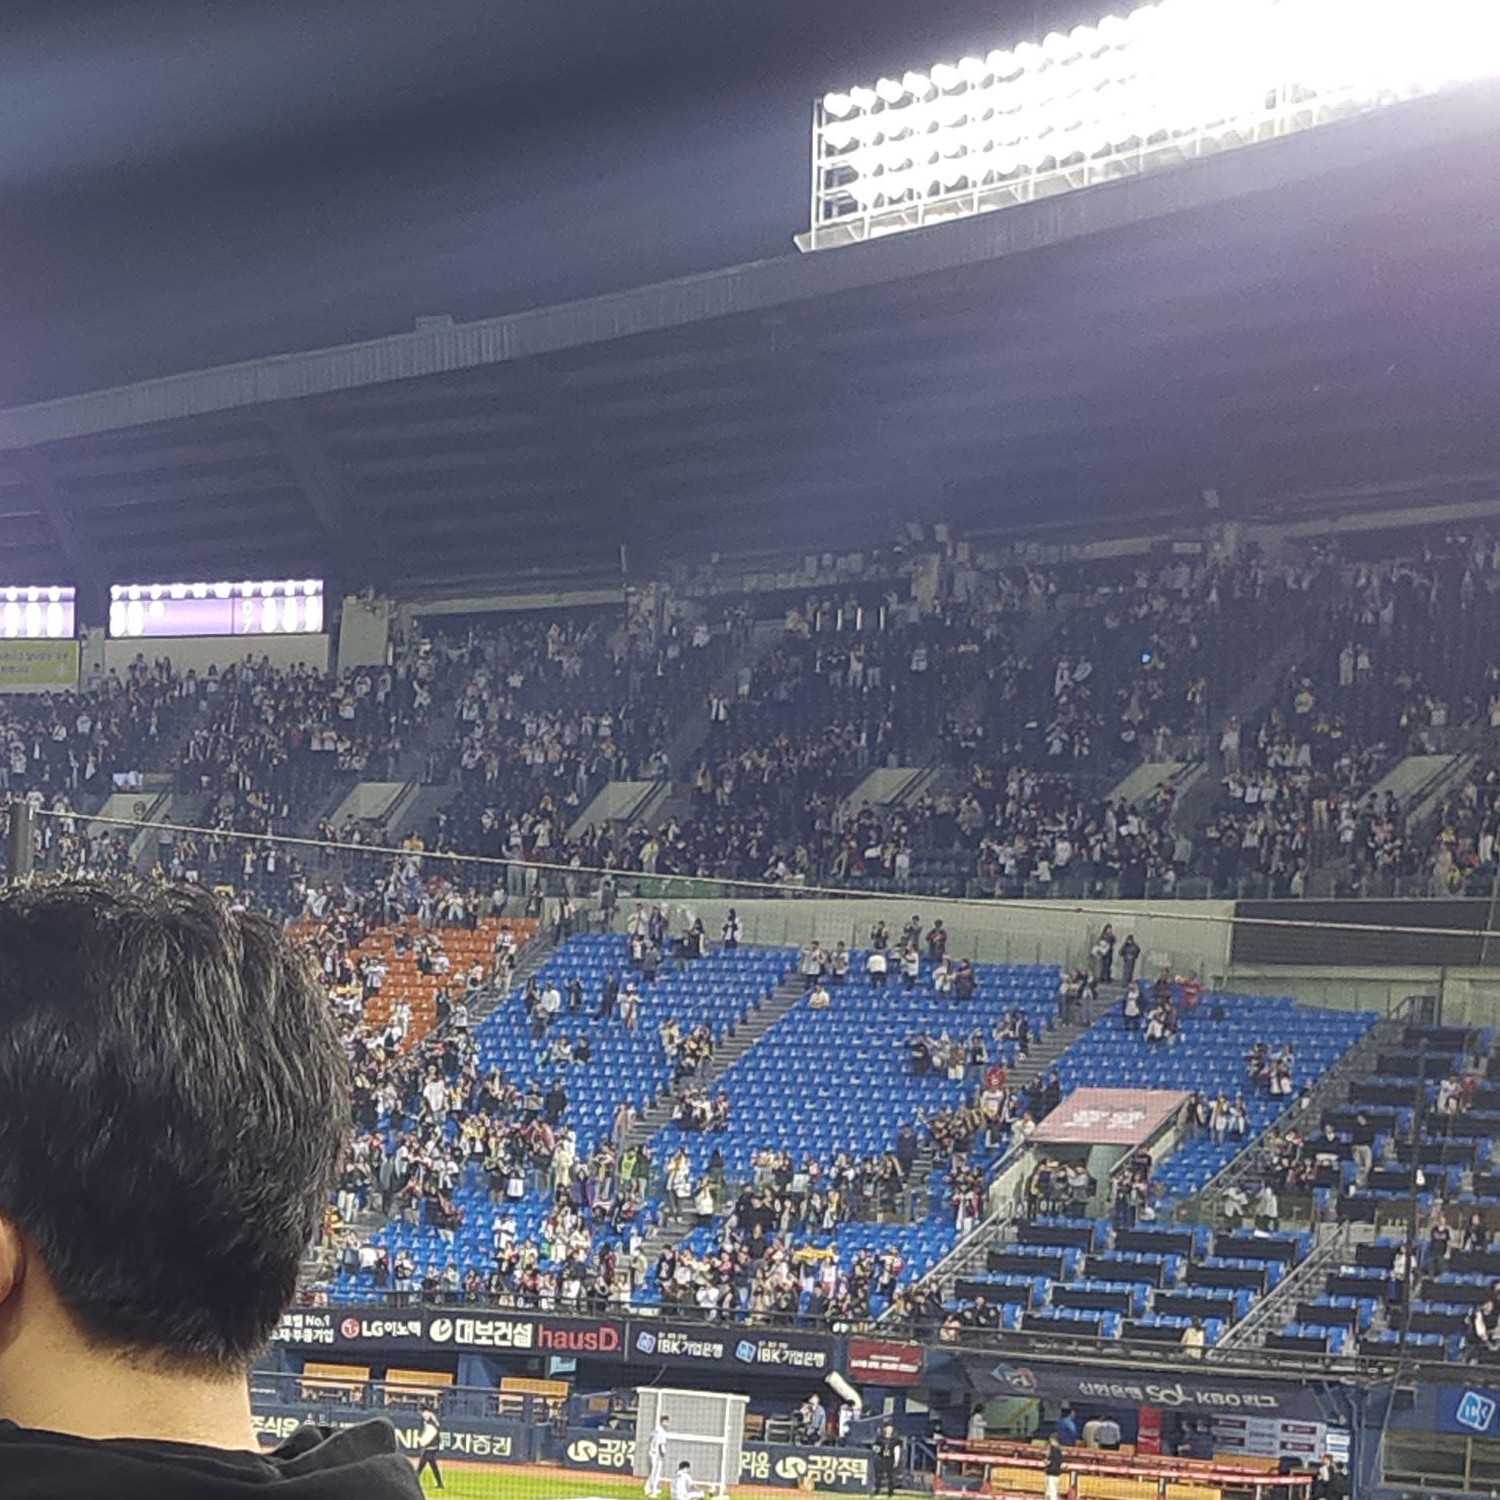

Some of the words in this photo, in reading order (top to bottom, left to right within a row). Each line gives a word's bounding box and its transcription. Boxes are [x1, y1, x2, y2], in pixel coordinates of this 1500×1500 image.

[455, 1318, 532, 1349] 대보건설
[657, 1339, 723, 1358] IBK기업은행
[807, 1455, 868, 1486] 금강주택
